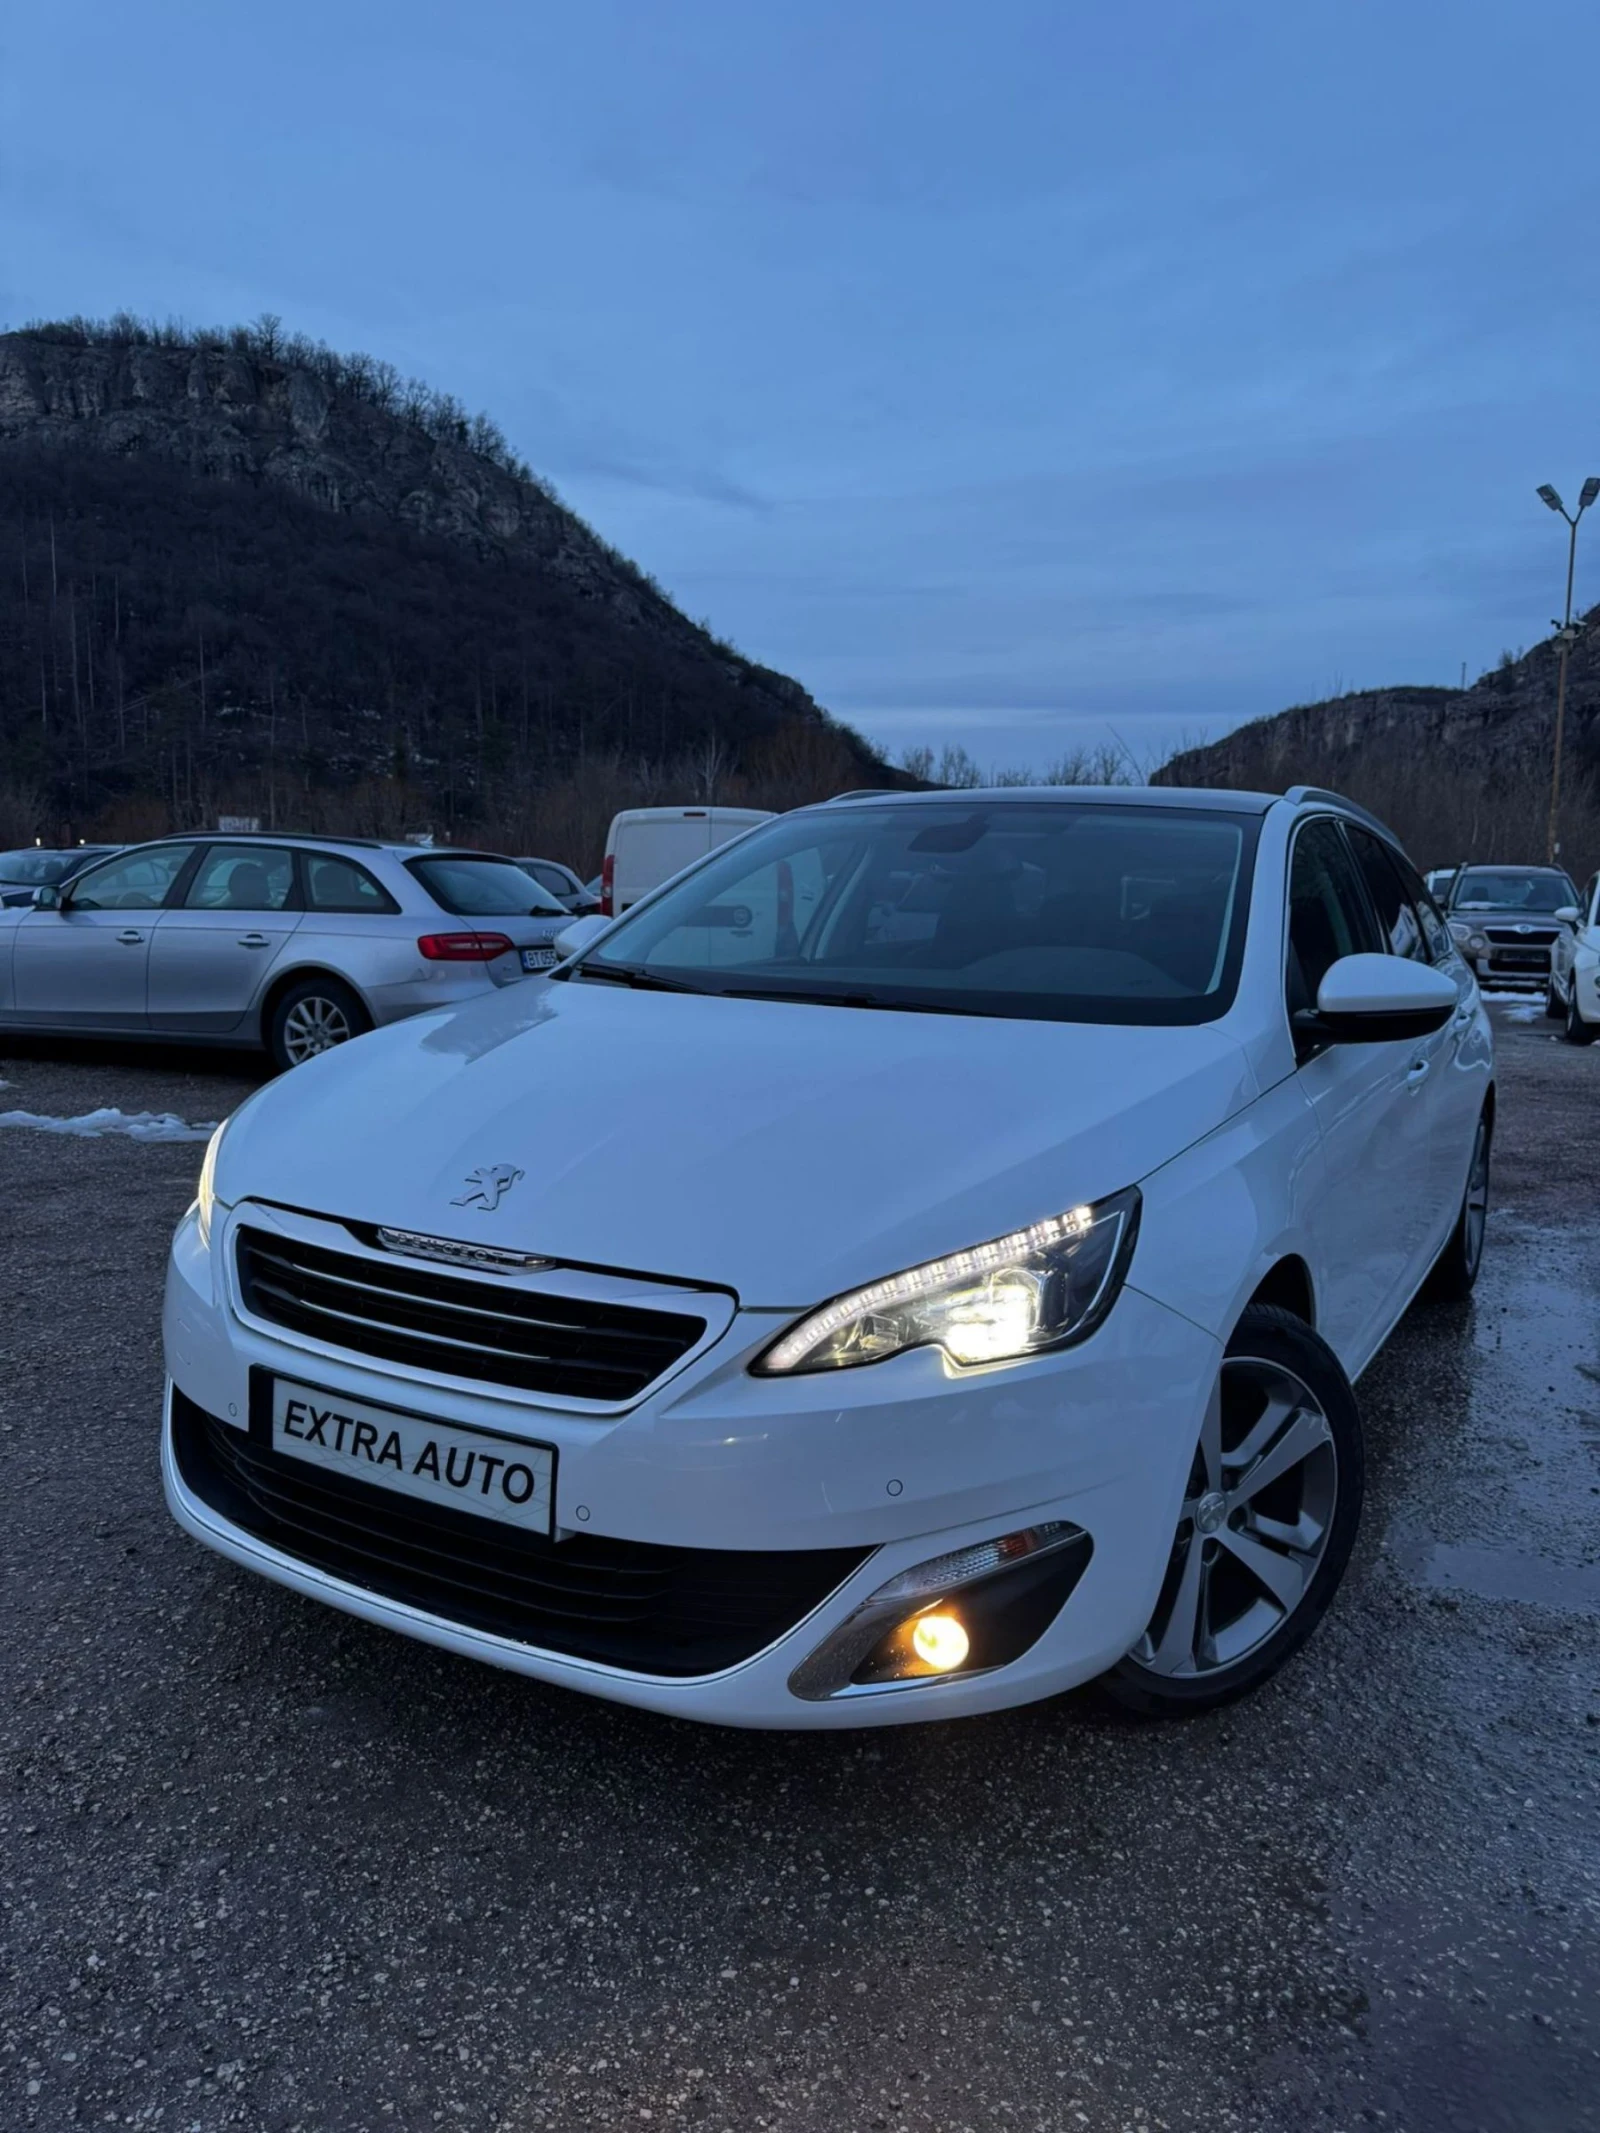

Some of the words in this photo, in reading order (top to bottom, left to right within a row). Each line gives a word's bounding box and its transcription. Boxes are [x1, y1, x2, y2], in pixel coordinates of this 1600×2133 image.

[397, 1232, 504, 1263] PEUGEOT
[284, 1399, 403, 1471] EXTRA
[412, 1441, 535, 1504] AUTO
